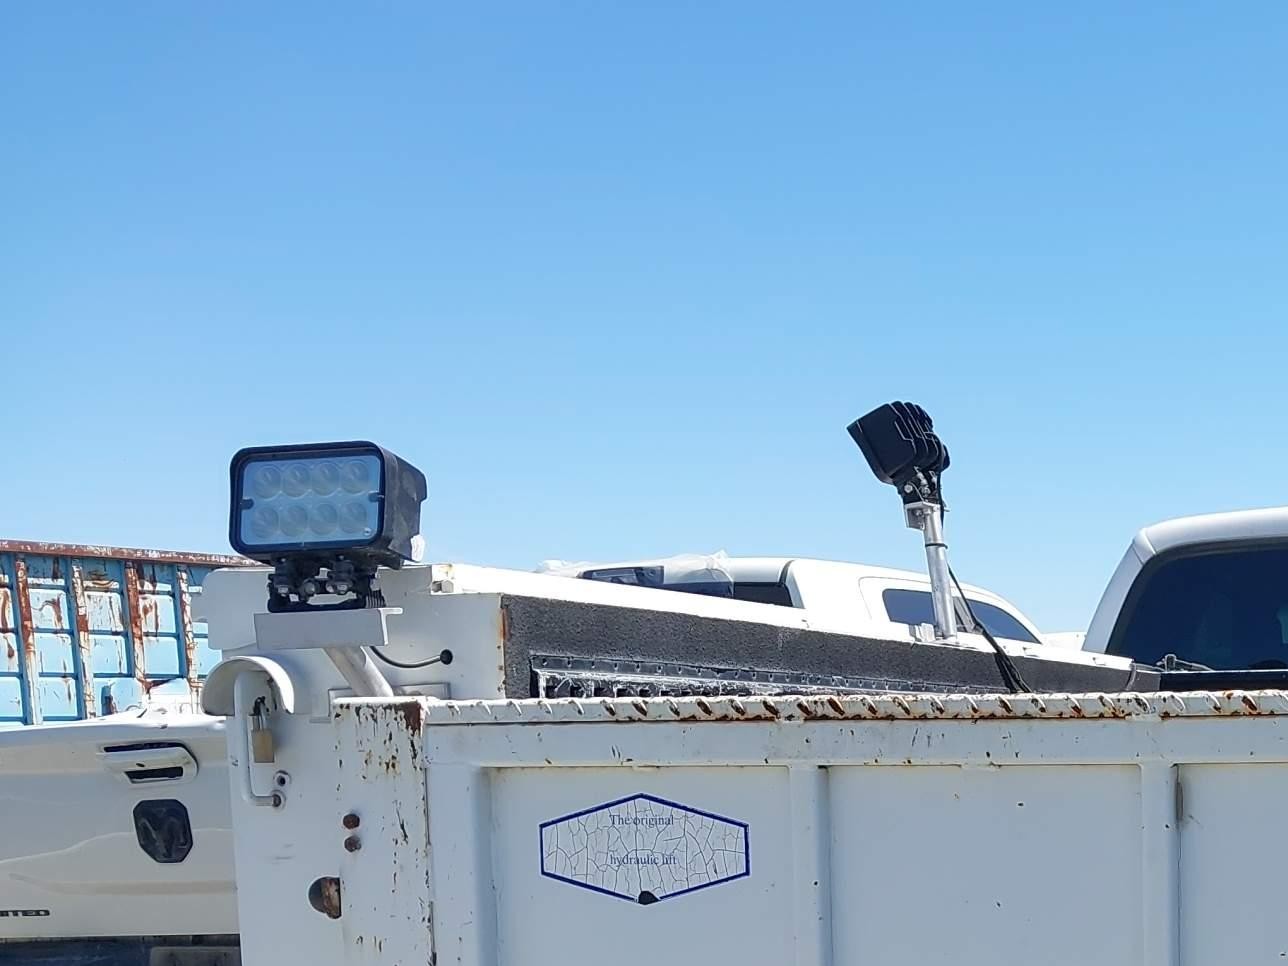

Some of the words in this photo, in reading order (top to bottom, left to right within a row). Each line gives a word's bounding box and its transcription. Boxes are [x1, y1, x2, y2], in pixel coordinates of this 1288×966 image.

[609, 814, 631, 826] The
[633, 814, 674, 828] original
[610, 854, 660, 866] hydraulic
[662, 854, 677, 865] lift
